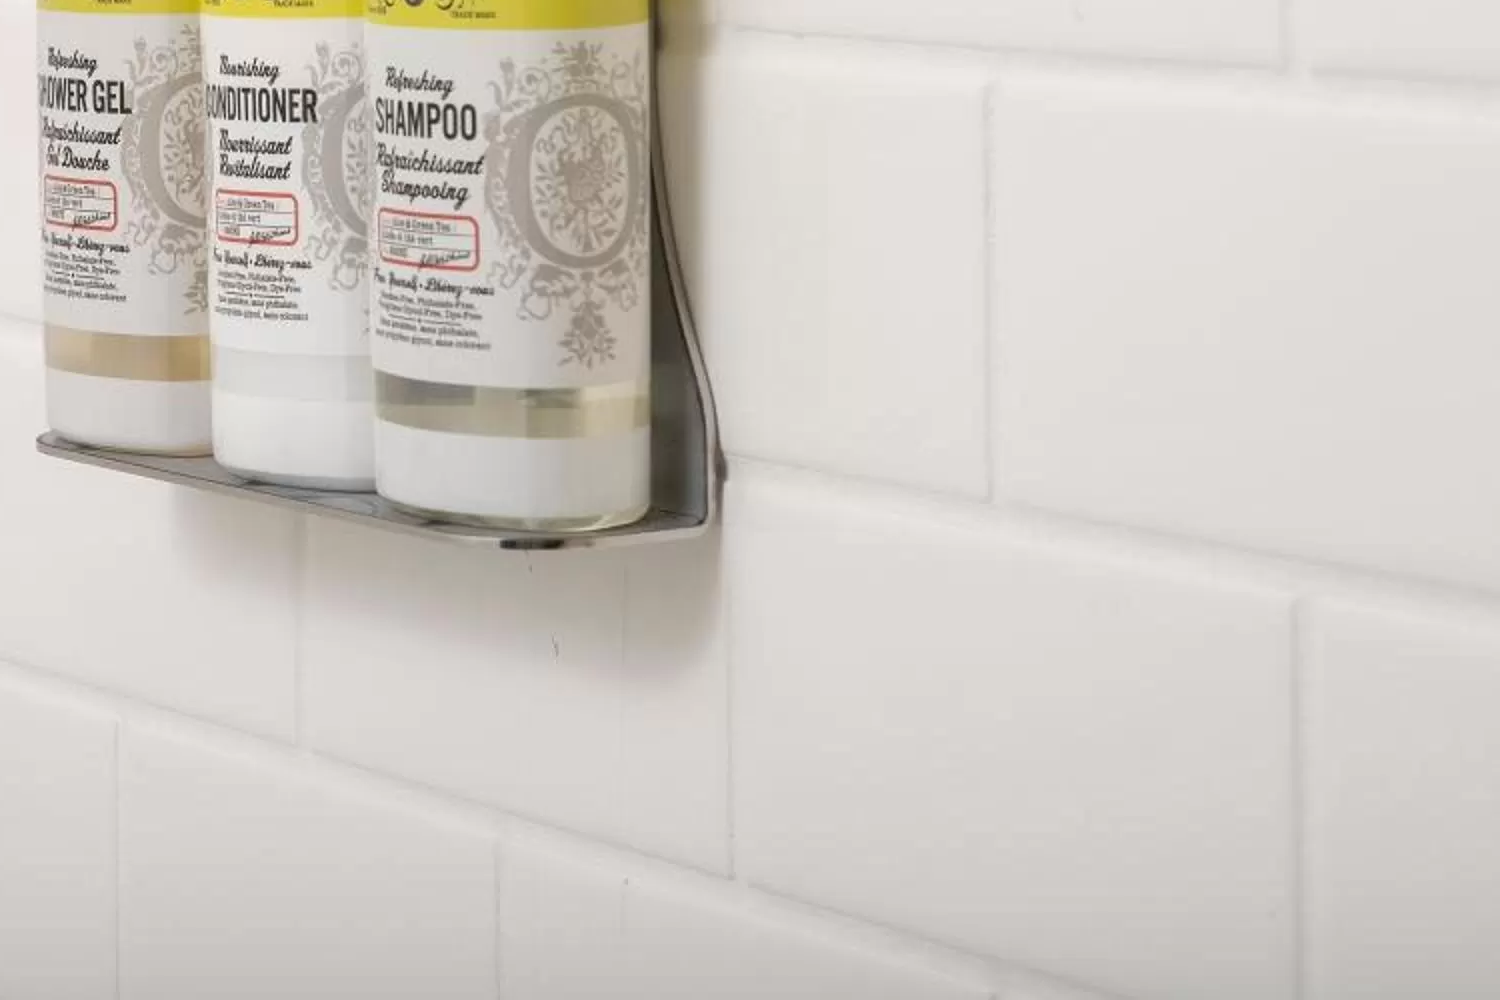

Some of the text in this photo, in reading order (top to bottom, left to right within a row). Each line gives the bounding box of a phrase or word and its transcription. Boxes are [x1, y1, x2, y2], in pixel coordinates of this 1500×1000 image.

[219, 54, 281, 86] Nourishing
[385, 66, 455, 100] Refreshing
[93, 80, 132, 114] GEL
[206, 83, 318, 124] CONDITIONER
[375, 96, 477, 141] SHAMPOO
[219, 128, 293, 155] Nourrissant
[62, 146, 110, 172] Douche
[219, 153, 291, 180] Revitalisant
[381, 169, 469, 211] Shampooing
